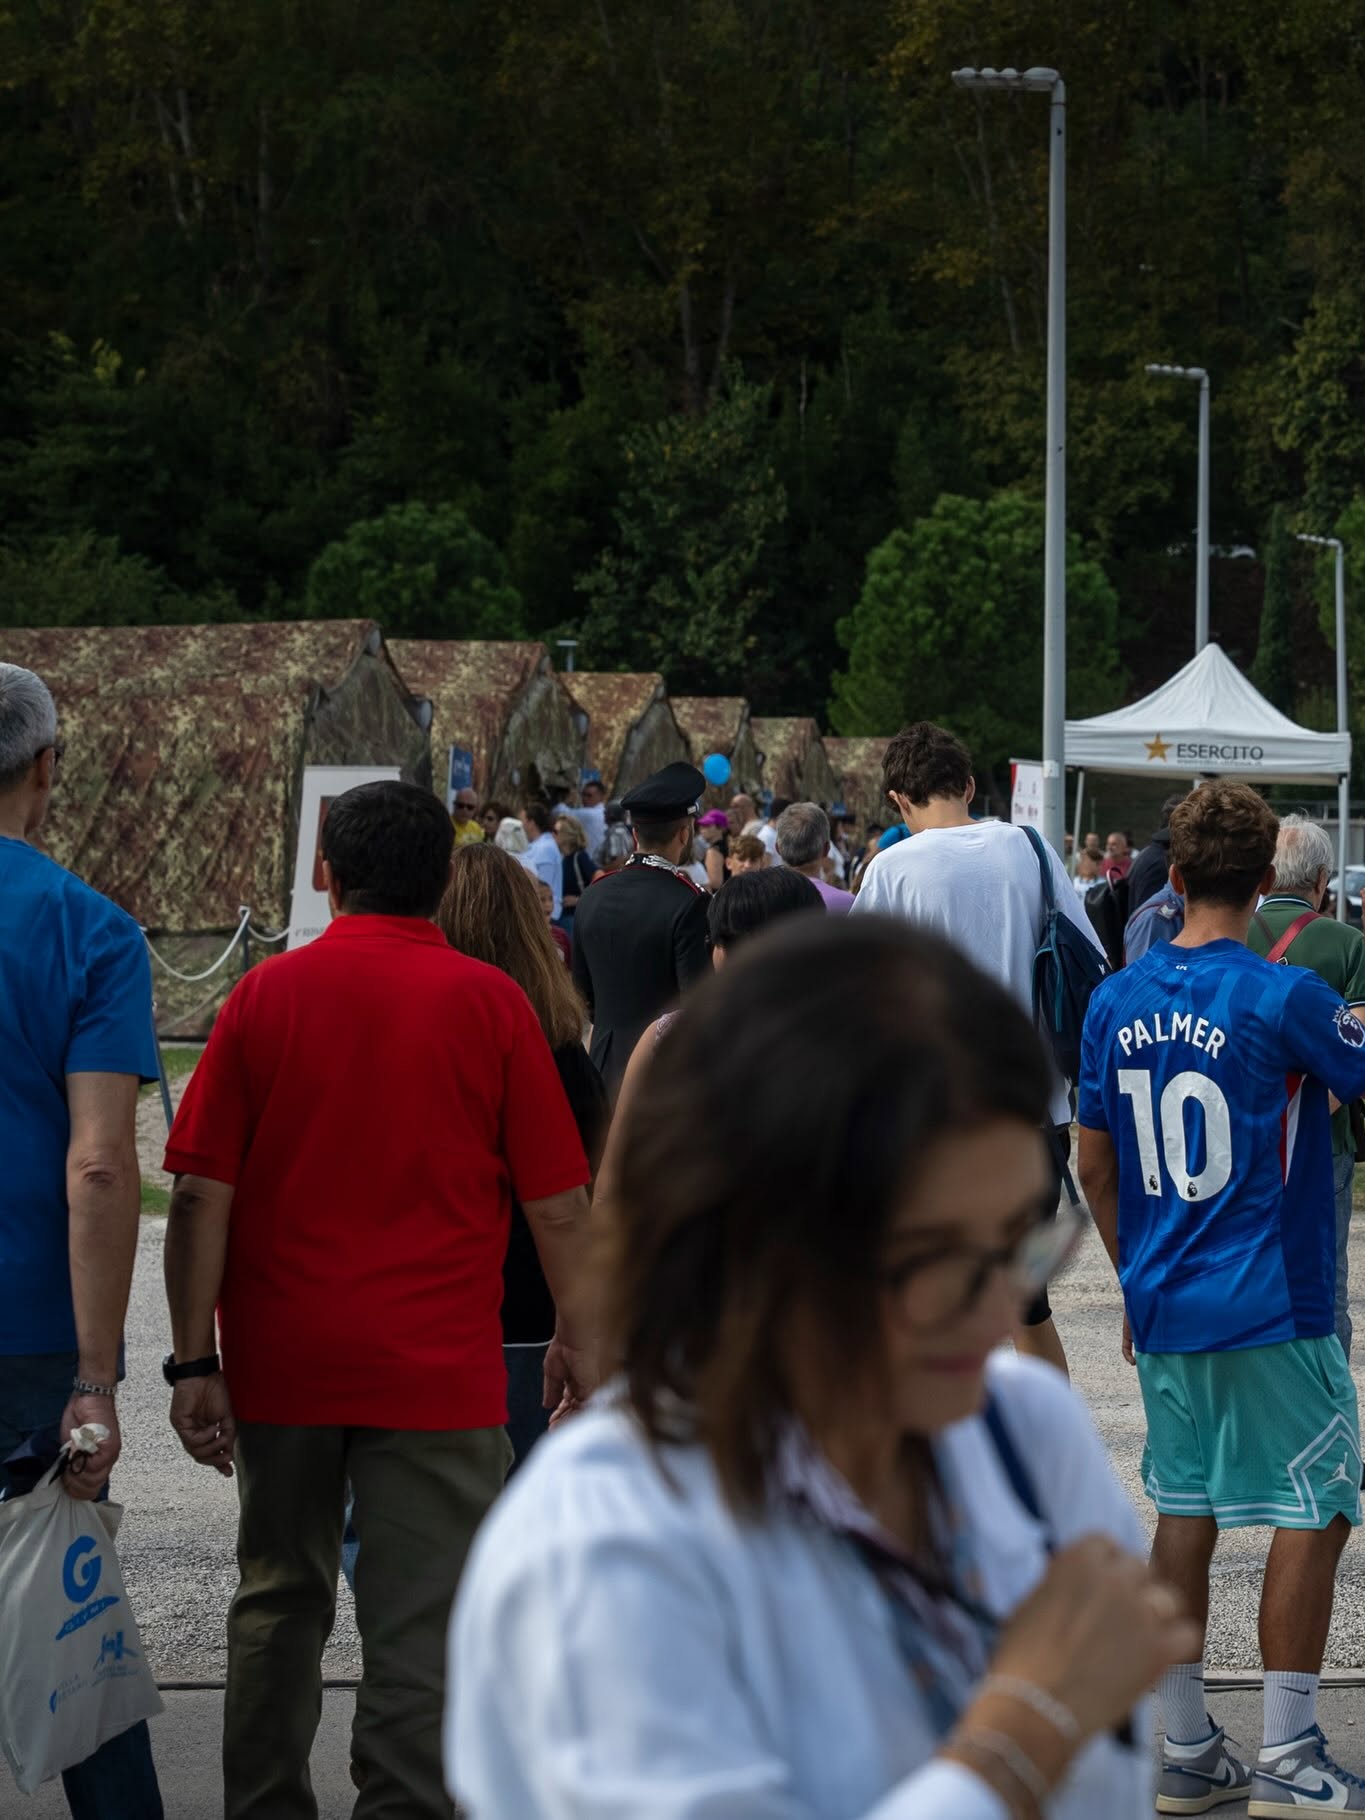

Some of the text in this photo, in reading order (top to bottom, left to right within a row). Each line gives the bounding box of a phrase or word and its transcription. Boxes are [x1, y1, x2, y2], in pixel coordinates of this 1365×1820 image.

[1176, 743, 1264, 760] ESERCITO
[1117, 1011, 1226, 1060] PALMER
[1117, 1068, 1233, 1202] 10
